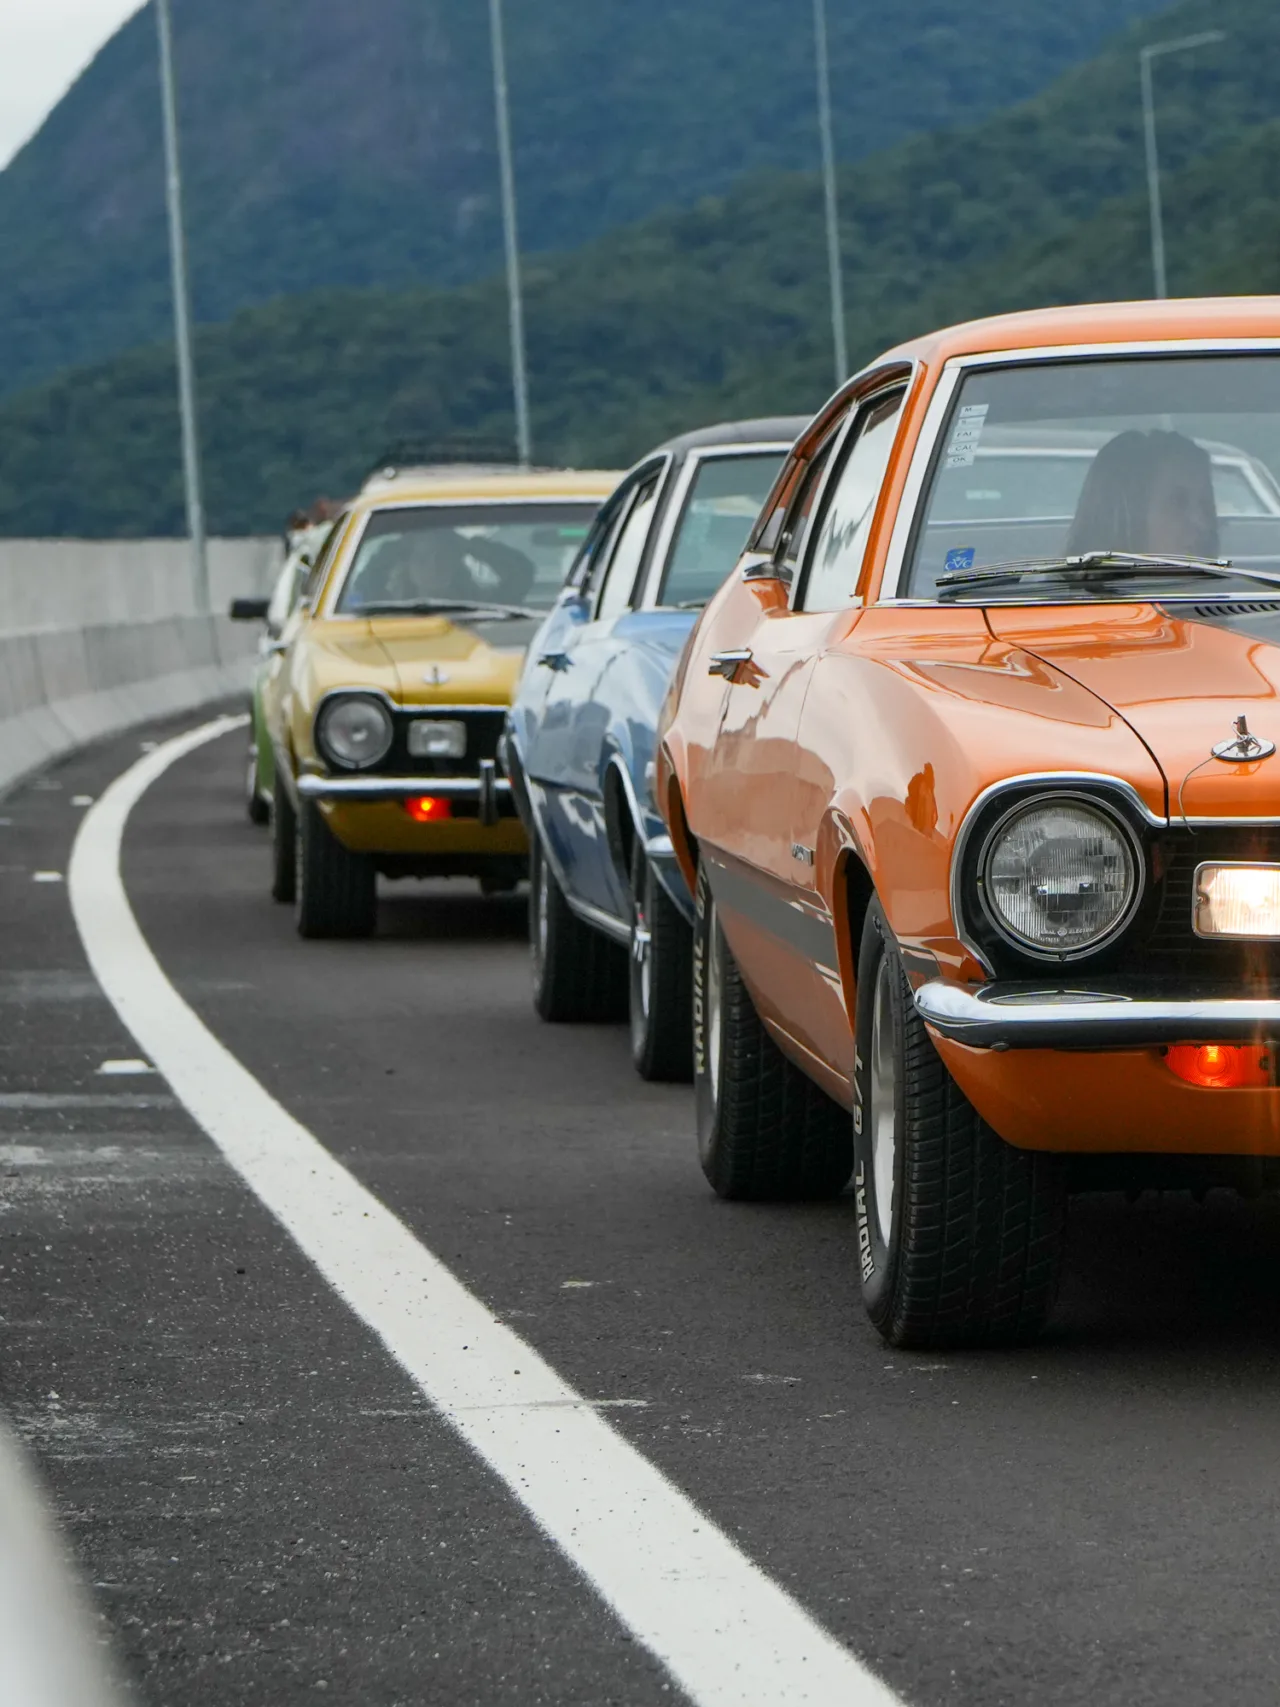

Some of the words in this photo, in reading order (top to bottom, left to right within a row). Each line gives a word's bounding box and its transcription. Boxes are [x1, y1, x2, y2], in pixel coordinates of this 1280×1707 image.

[693, 937, 706, 1075] RADIAL
[853, 1044, 864, 1135] G/T
[855, 1159, 875, 1283] RADIAL
